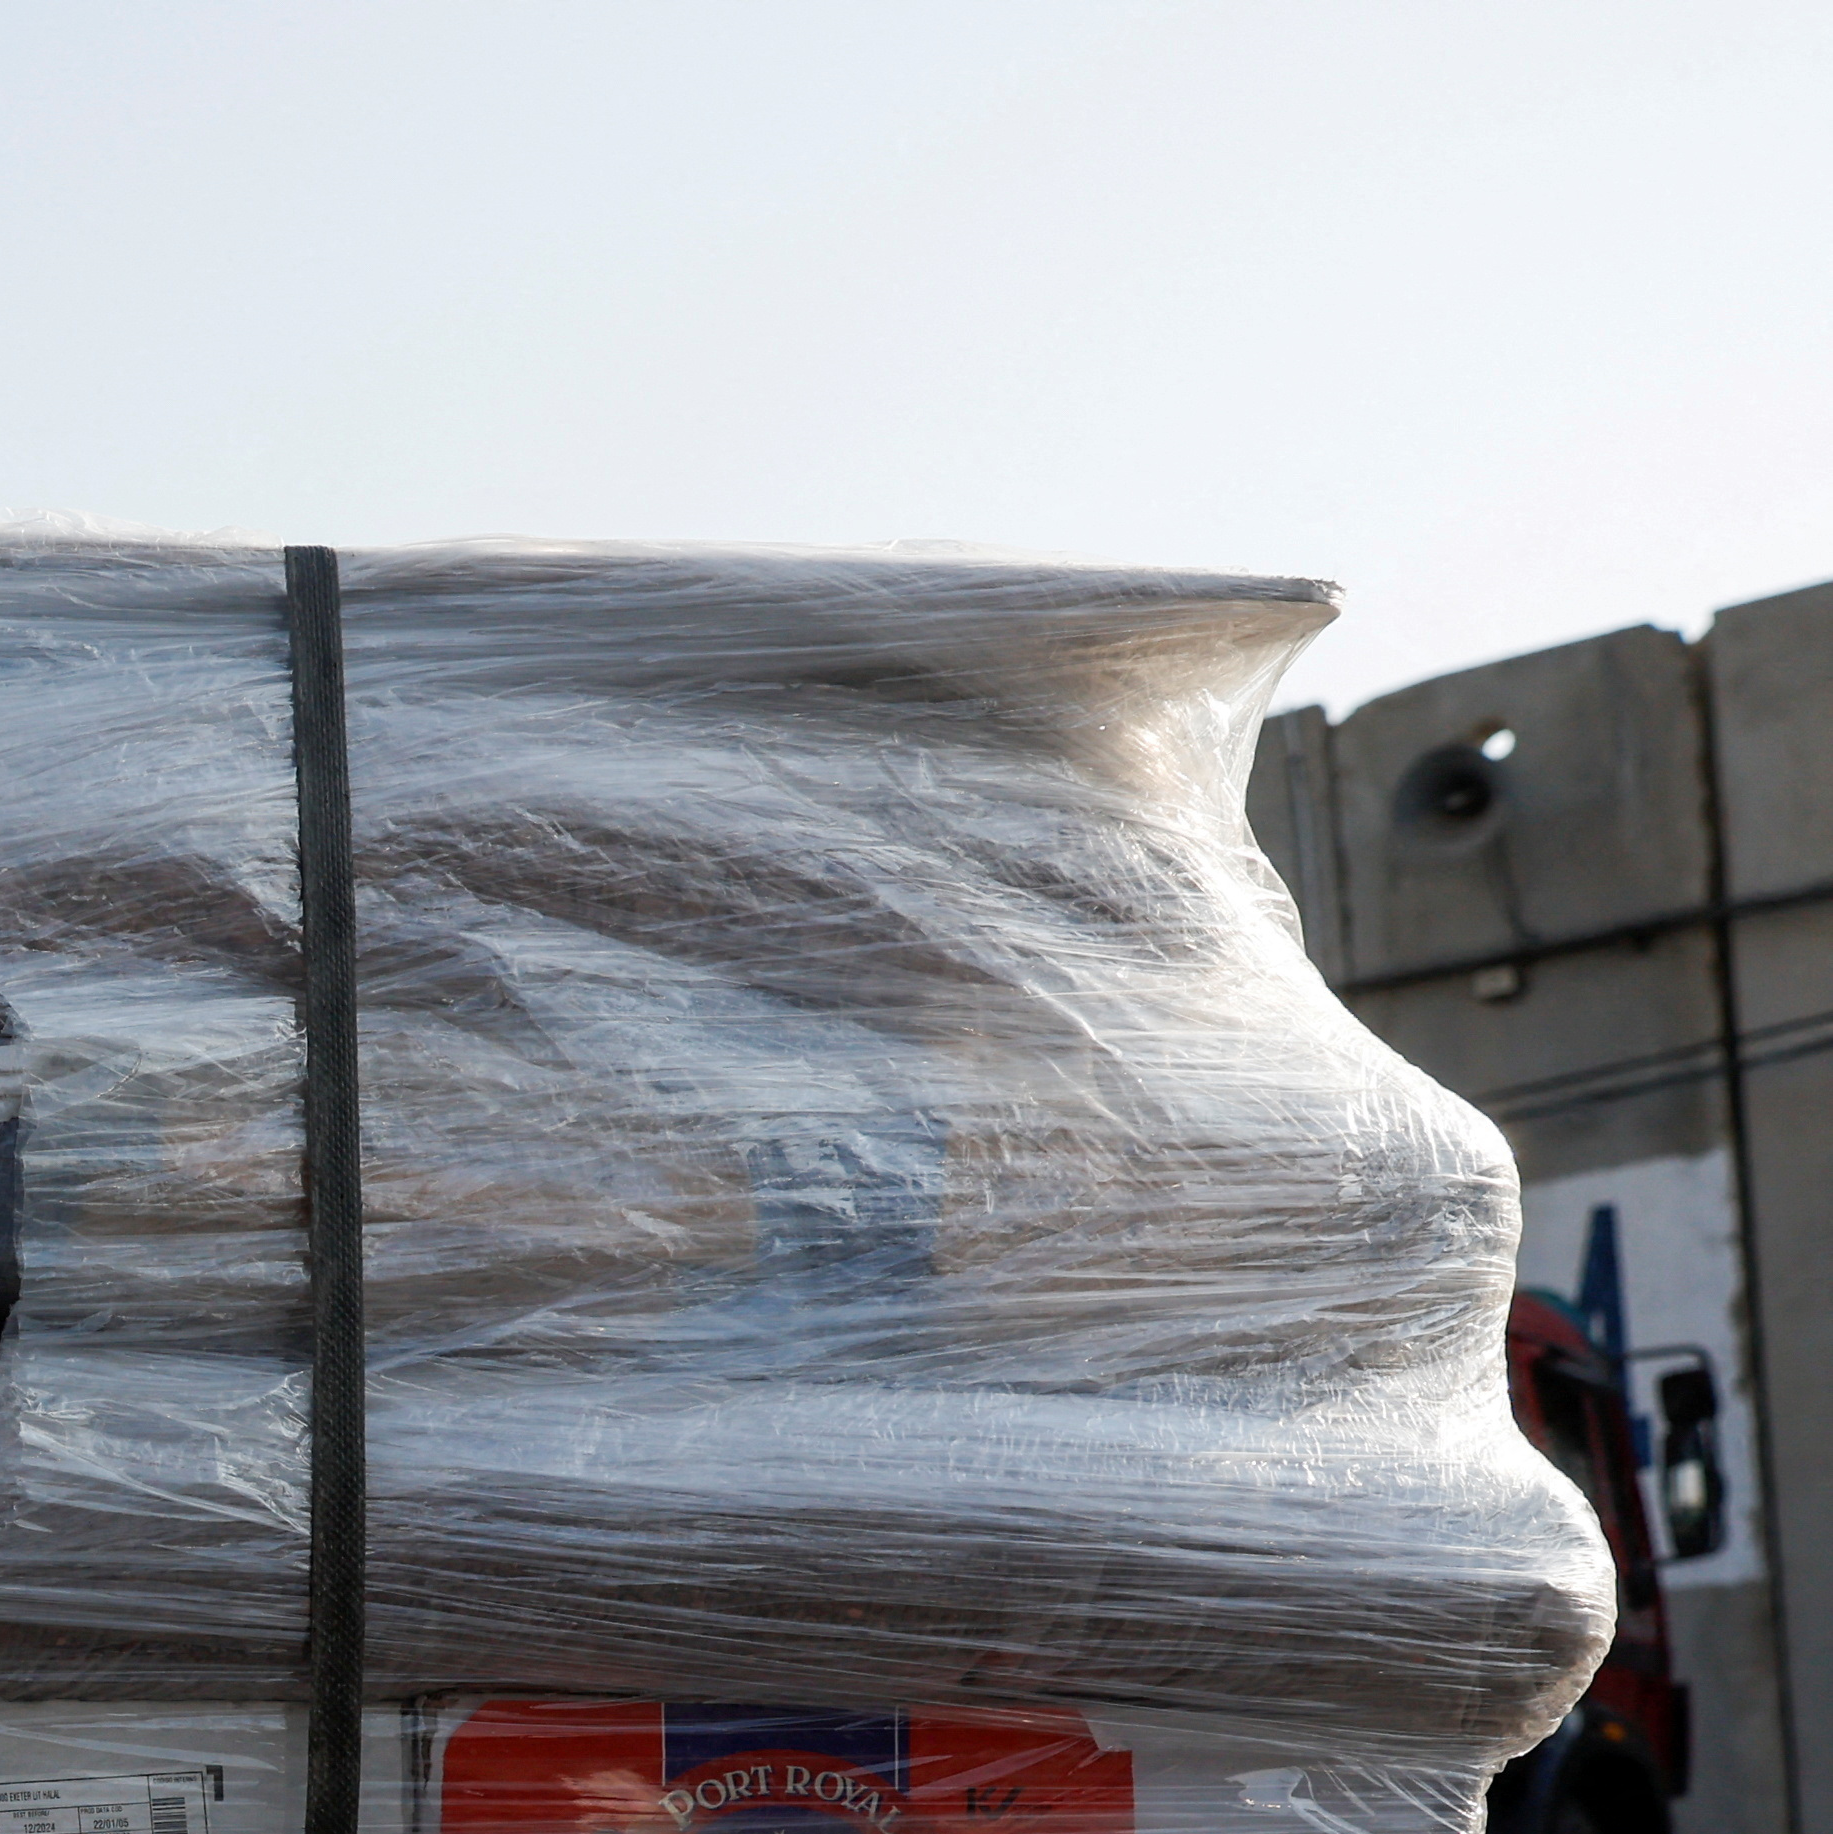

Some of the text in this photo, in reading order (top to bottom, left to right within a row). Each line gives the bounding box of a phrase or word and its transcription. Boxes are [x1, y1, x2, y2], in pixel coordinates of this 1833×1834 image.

[658, 1764, 773, 1832] PORT
[24, 1823, 55, 1834] 12/2024
[93, 1818, 129, 1830] 22/01/05
